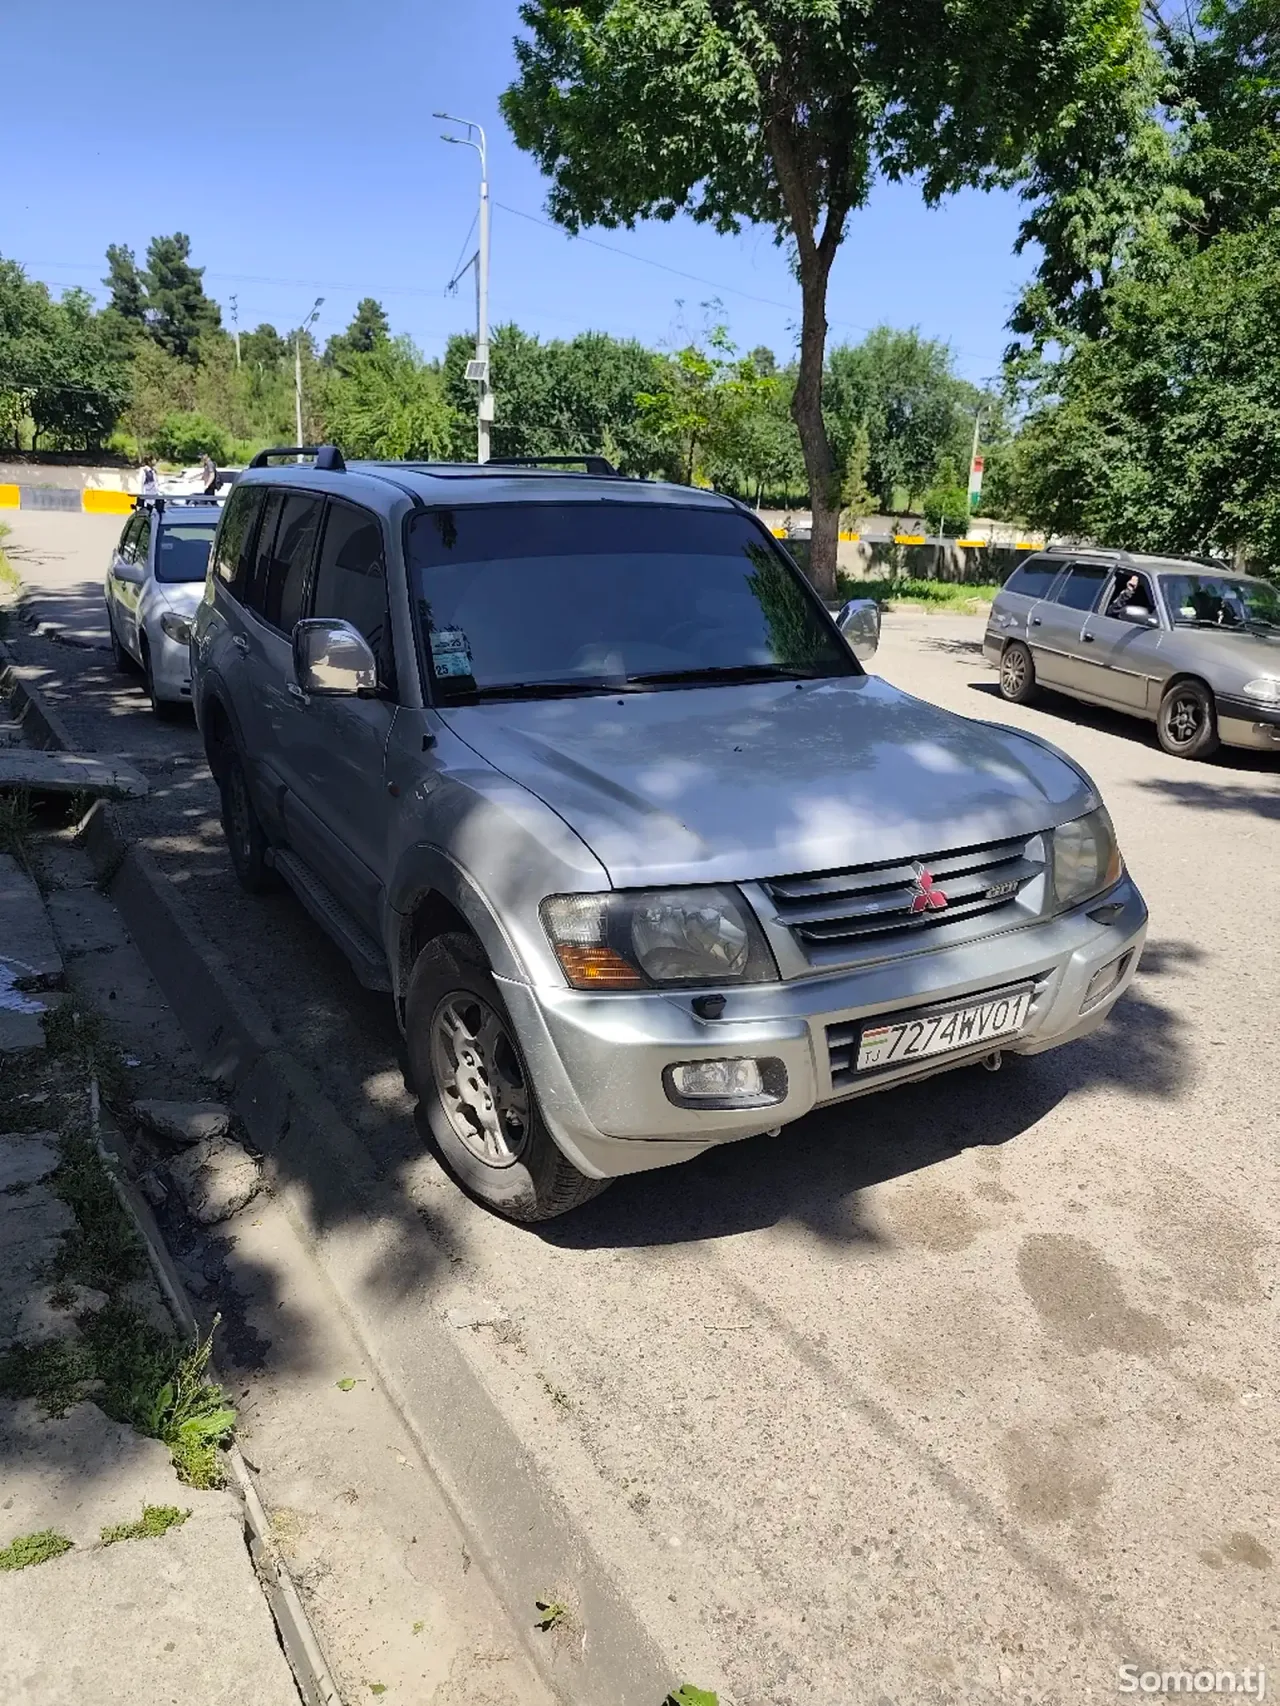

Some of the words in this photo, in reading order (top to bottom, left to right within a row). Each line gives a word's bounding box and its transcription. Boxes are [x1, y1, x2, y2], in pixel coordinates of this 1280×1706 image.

[436, 664, 448, 675] 25
[886, 995, 1023, 1060] 7274WV01
[864, 1049, 881, 1064] TJ
